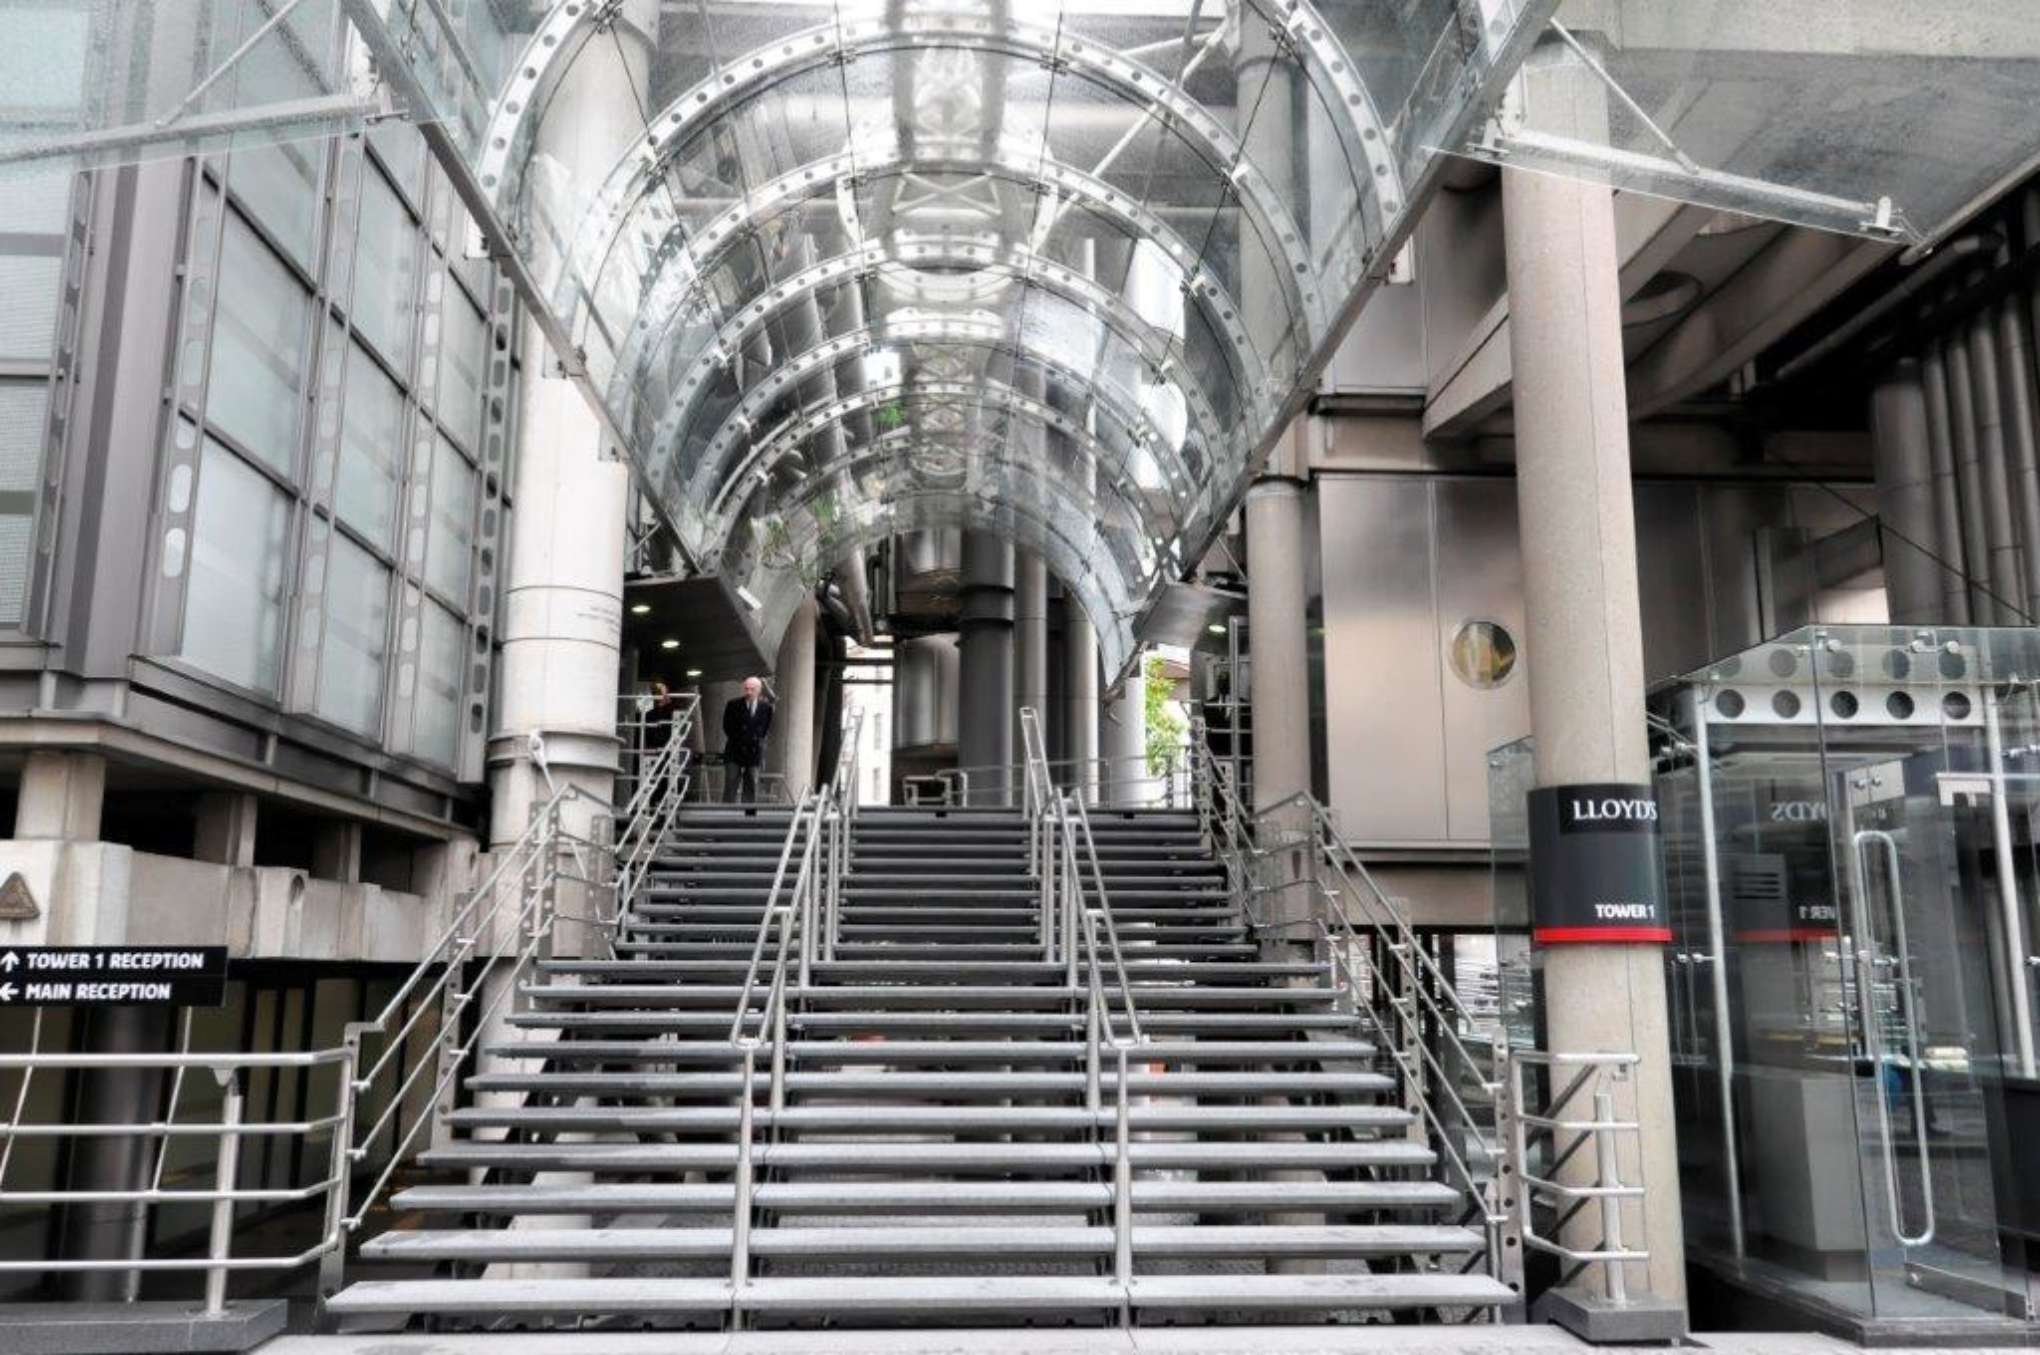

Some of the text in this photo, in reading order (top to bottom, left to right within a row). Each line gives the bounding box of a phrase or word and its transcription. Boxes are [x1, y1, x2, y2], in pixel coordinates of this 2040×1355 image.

[1595, 904, 1655, 919] TOWER 1
[26, 953, 204, 969] TOWER 1 RECEPTION
[25, 983, 172, 999] MAIN RECEPTION
